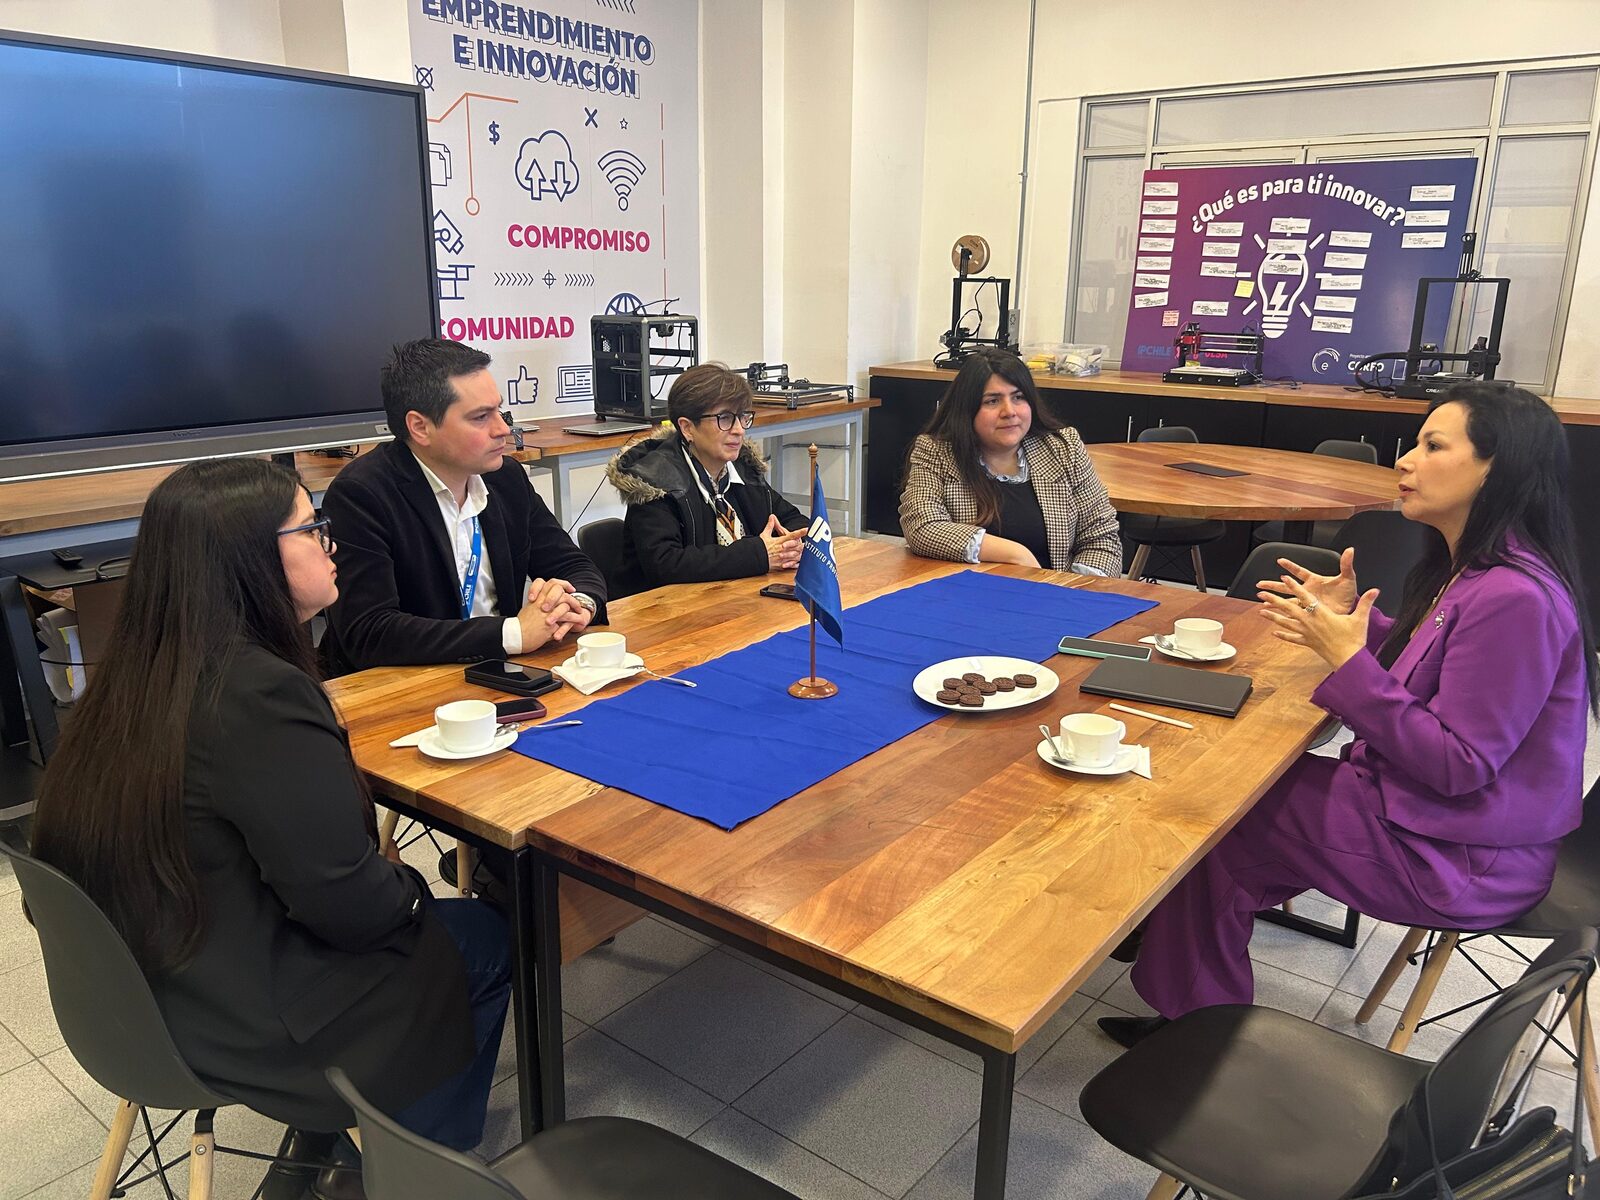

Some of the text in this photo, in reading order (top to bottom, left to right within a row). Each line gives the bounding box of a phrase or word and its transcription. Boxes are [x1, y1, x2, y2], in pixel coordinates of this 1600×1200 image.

[422, 0, 652, 61] EMPRENDIMIENTO
[453, 34, 637, 96] E INNOVACIÓN
[1192, 190, 1235, 233] ¿Qué
[1237, 185, 1258, 204] es
[1263, 178, 1304, 201] para
[1307, 173, 1324, 194] ti
[1324, 174, 1406, 227] innovar?
[508, 224, 650, 253] COMPROMISO
[440, 316, 575, 342] OMUNIDAD
